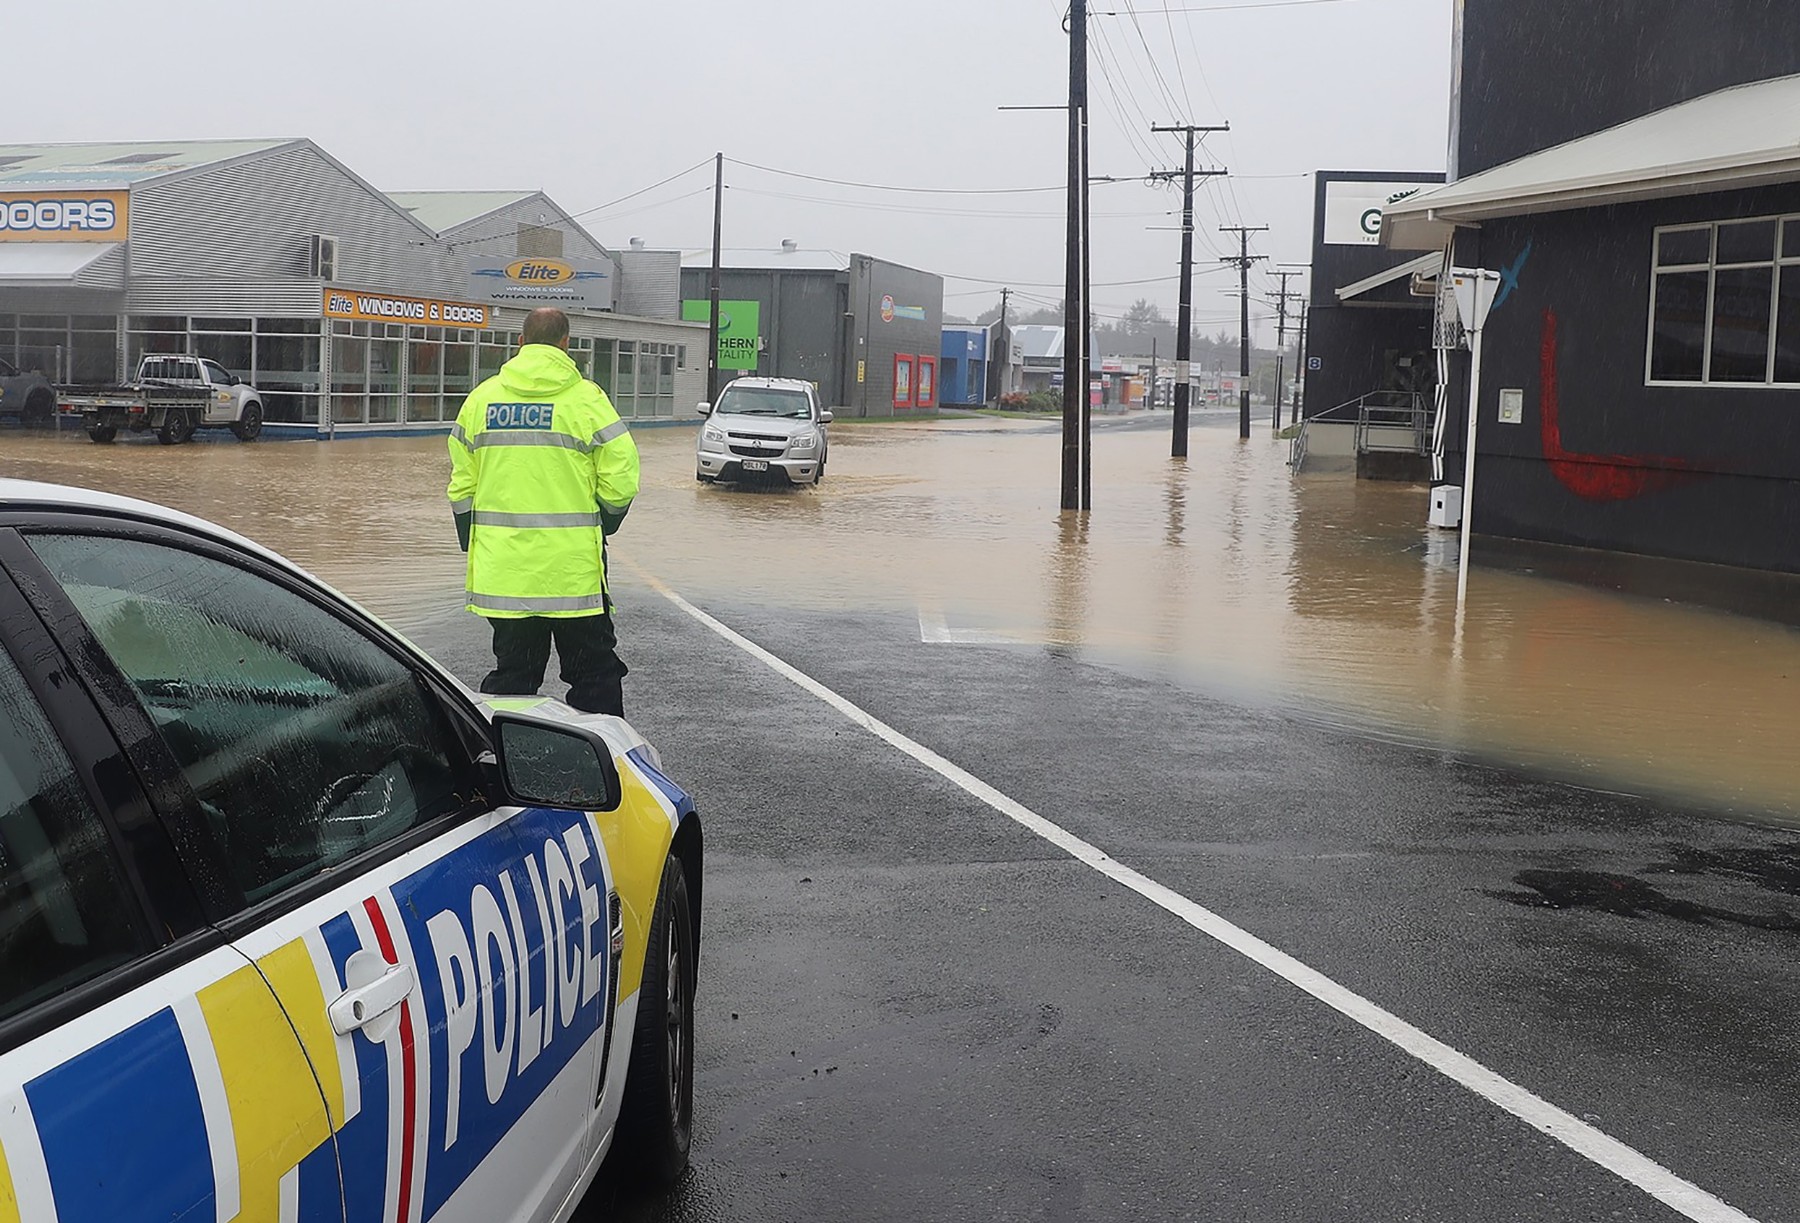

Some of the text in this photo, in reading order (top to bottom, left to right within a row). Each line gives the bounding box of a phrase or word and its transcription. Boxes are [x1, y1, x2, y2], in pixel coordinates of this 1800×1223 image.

[518, 262, 560, 280] Élite
[491, 293, 584, 301] WHANGAREI
[328, 294, 484, 322] Élite WINDOWS & DOORS
[719, 338, 755, 349] HERN
[719, 350, 754, 360] TALITY
[487, 405, 552, 426] POLICE
[426, 822, 601, 1152] POLICE
